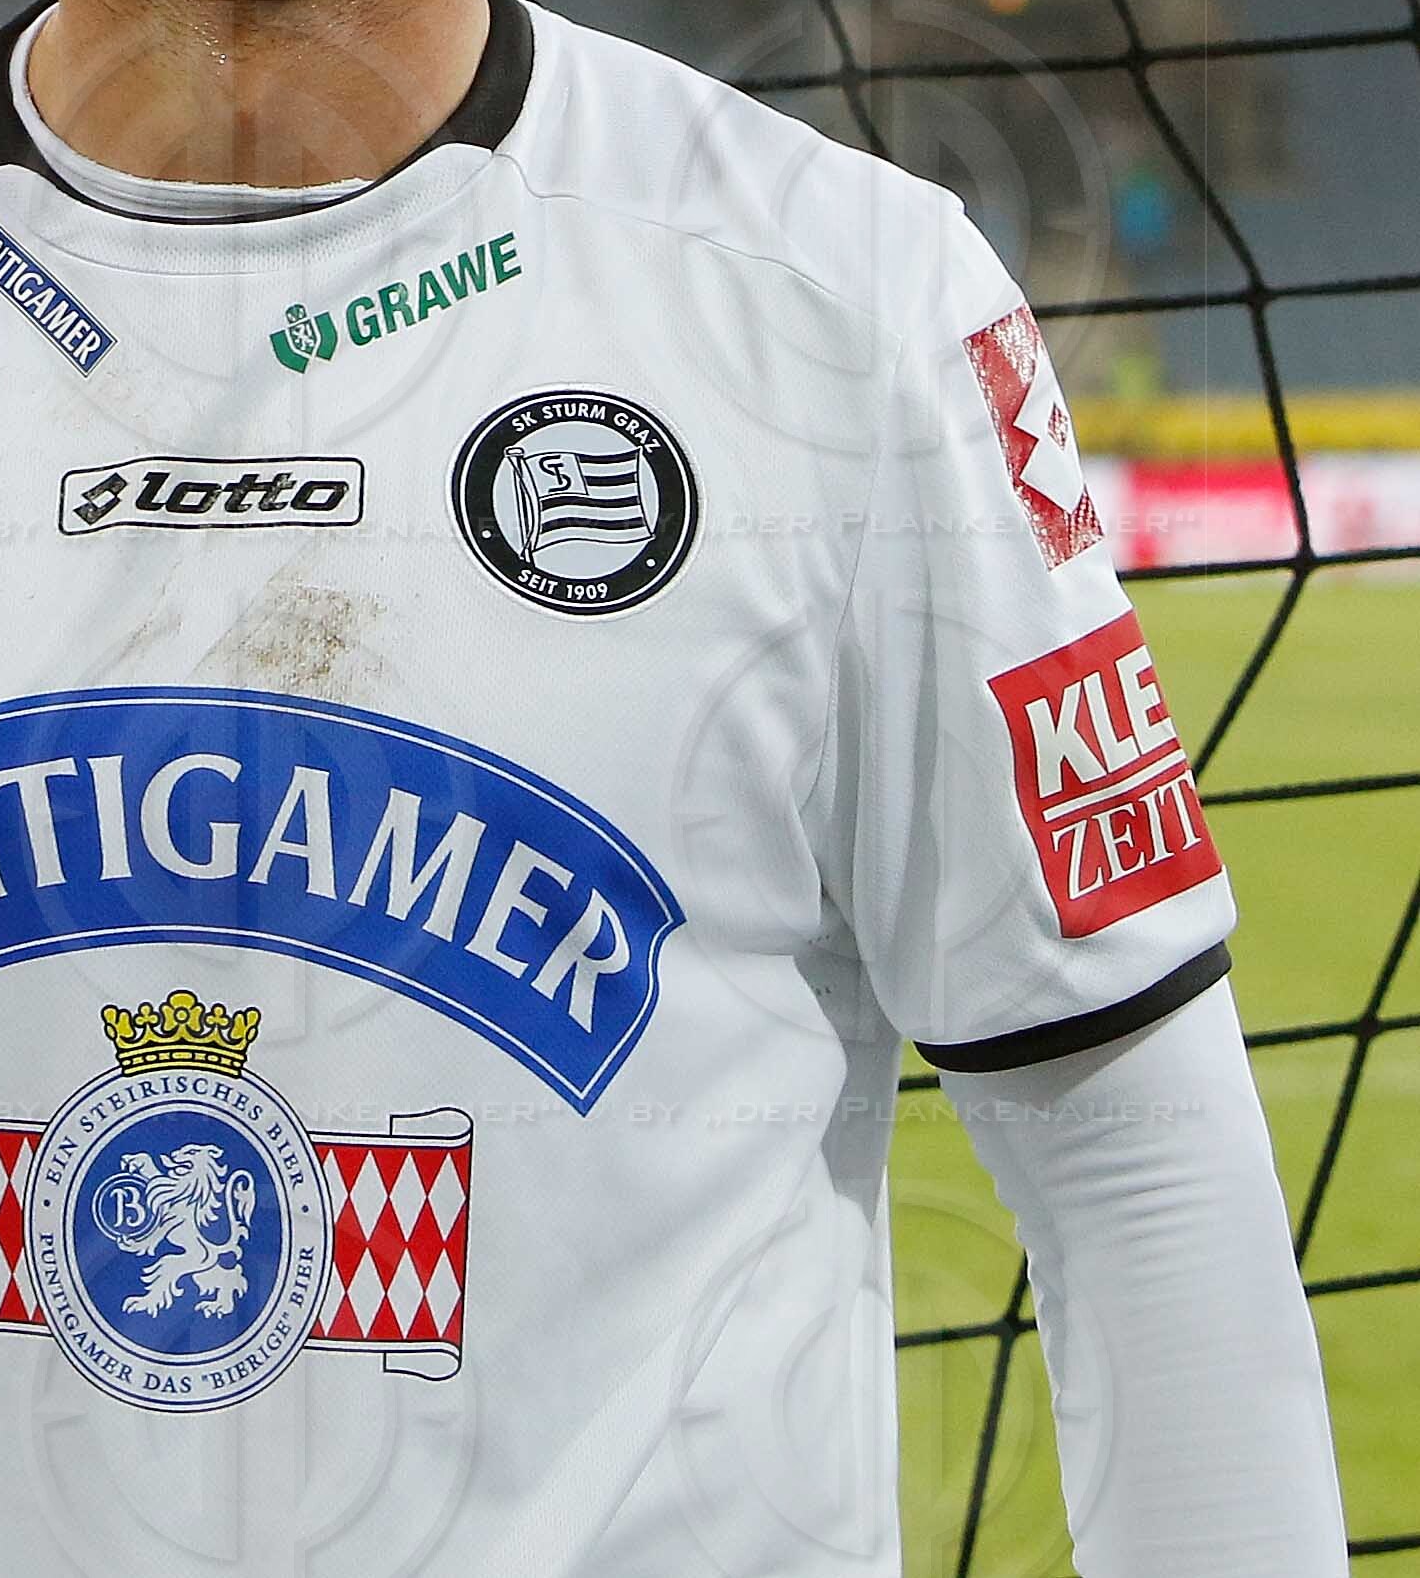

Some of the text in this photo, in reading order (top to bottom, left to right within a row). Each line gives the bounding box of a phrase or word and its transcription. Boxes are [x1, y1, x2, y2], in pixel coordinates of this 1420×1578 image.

[345, 232, 522, 346] GRAWE
[512, 403, 661, 453] SK STURM GRAZ
[134, 471, 348, 514] lotto
[518, 569, 608, 600] SEIT 1909
[1051, 769, 1202, 900] ZEIT
[46, 1075, 306, 1191] EIN STEIRISCHES BIER
[40, 1233, 134, 1384] PUNTIGAMER
[143, 1372, 193, 1394] DAS
[291, 1244, 315, 1309] BIER
